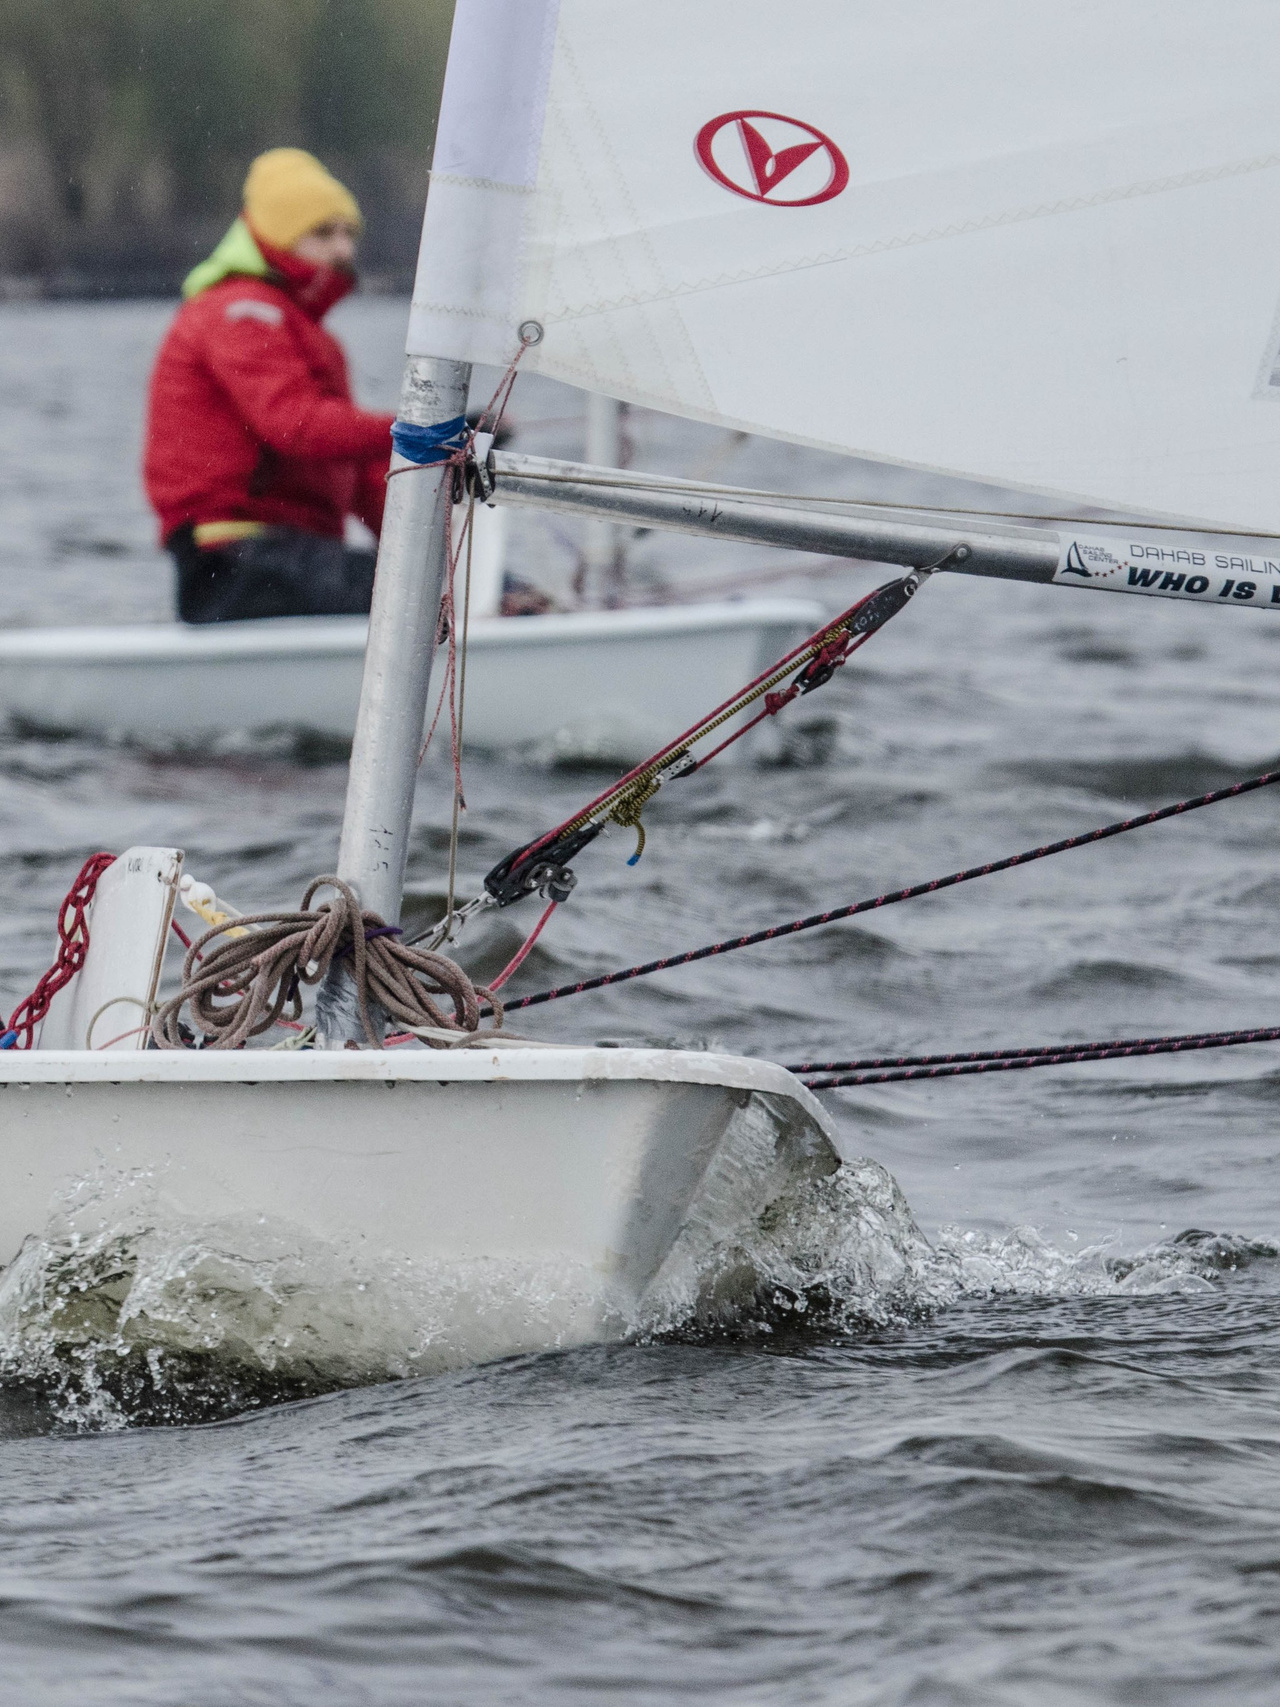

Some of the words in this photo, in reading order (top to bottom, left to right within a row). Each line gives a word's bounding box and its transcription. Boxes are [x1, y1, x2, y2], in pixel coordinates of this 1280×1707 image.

[1130, 545, 1206, 566] DAHAB
[1127, 566, 1210, 594] WHO
[1218, 579, 1257, 600] IS
